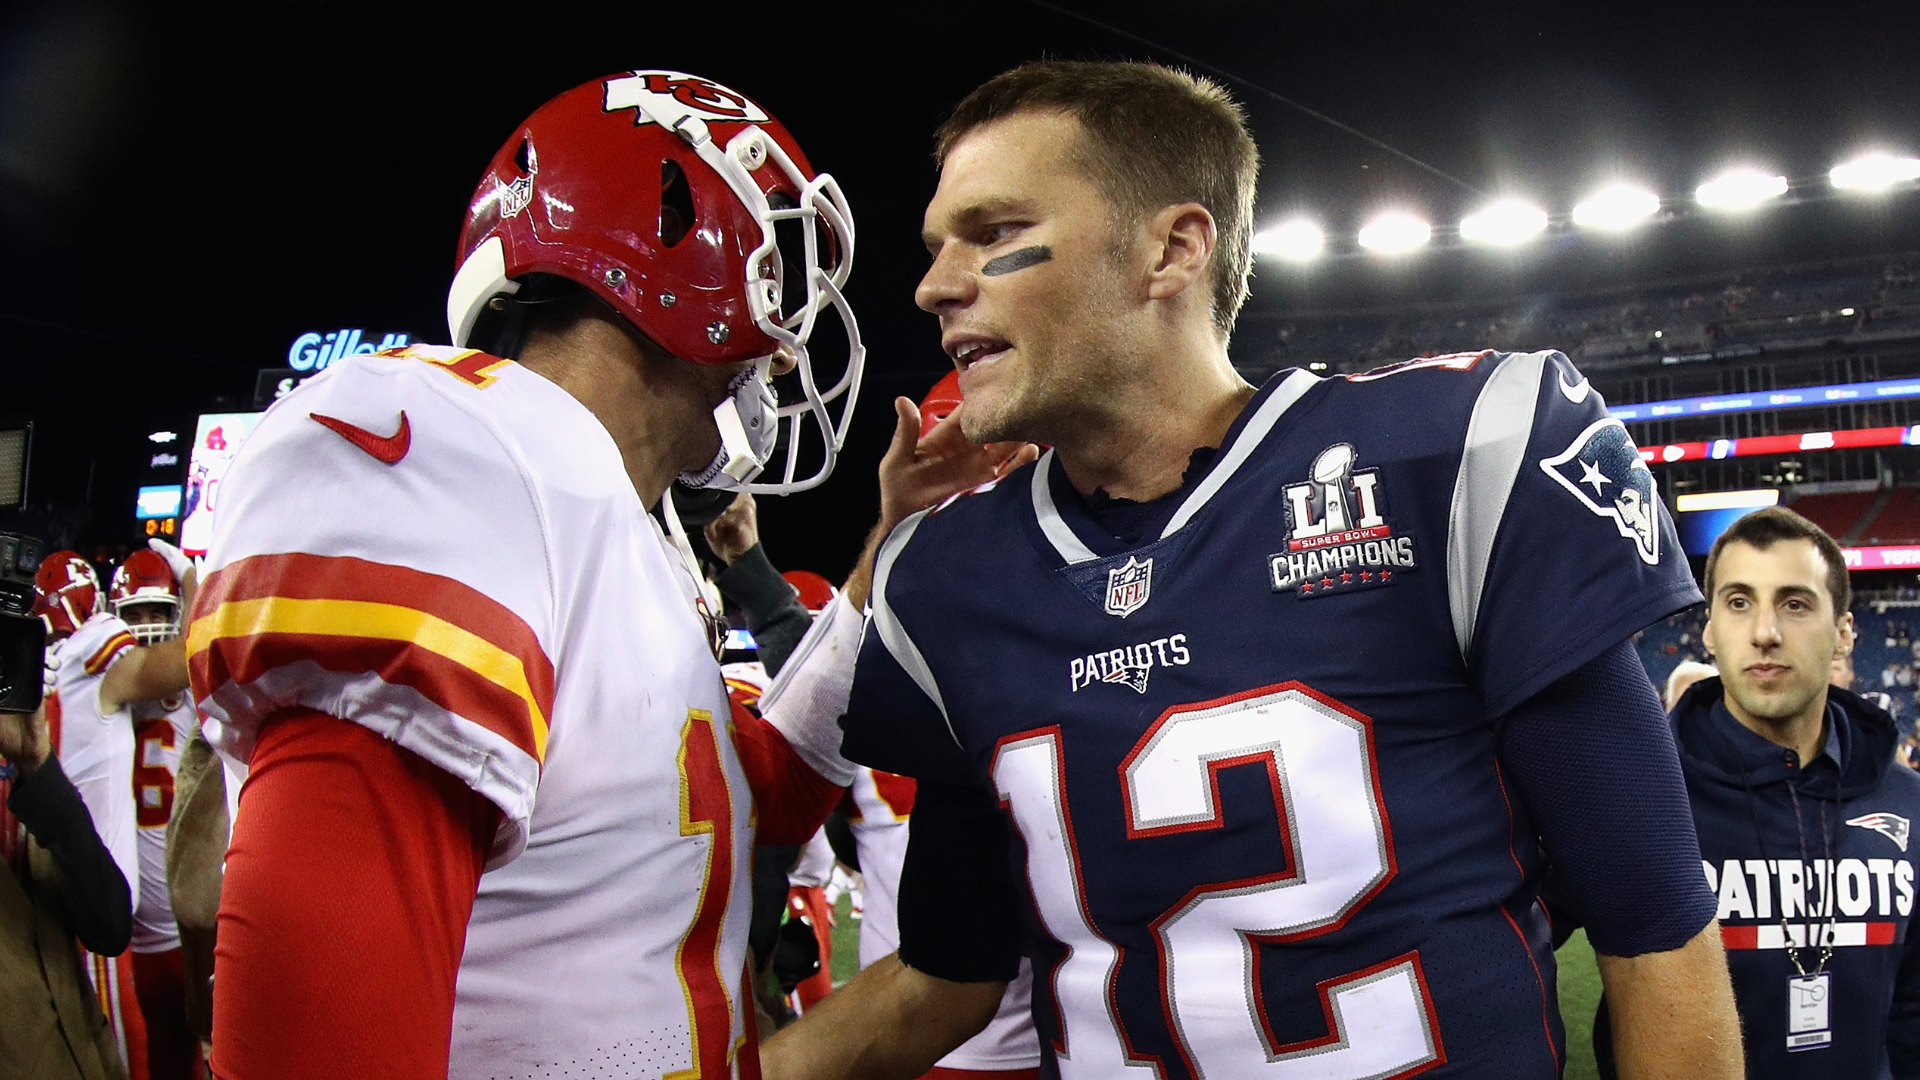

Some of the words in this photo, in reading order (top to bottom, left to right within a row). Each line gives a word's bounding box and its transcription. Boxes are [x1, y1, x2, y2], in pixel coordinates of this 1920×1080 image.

[1271, 536, 1415, 586] CHAMPIONS
[1301, 535, 1341, 548] SUPER
[1344, 529, 1378, 541] BOWL
[1113, 582, 1143, 607] NFL
[1070, 633, 1191, 693] PATRIOTS
[988, 680, 1448, 1080] 12
